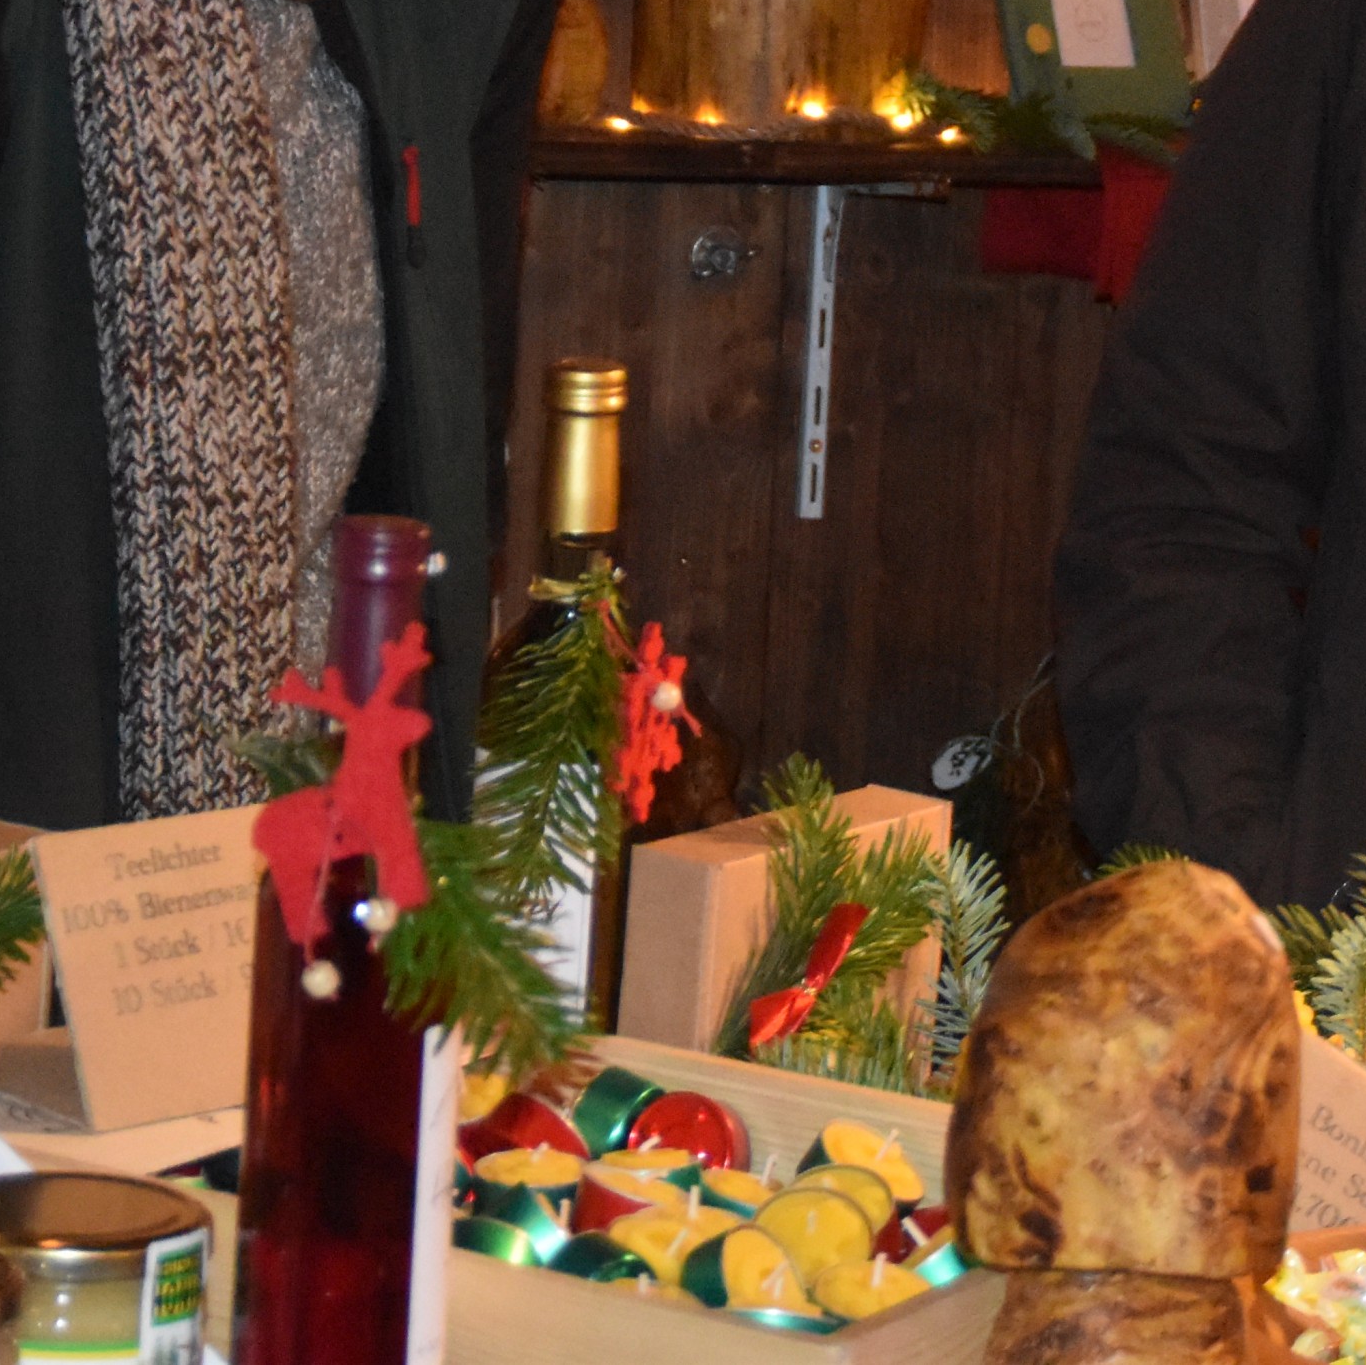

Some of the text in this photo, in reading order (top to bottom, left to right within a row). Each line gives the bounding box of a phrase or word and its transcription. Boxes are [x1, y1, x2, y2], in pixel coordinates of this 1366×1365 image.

[104, 842, 221, 881] Teelichter
[61, 897, 130, 934] 100%
[134, 928, 202, 965] Stück
[111, 984, 144, 1016] 10
[150, 970, 219, 1007] Stück
